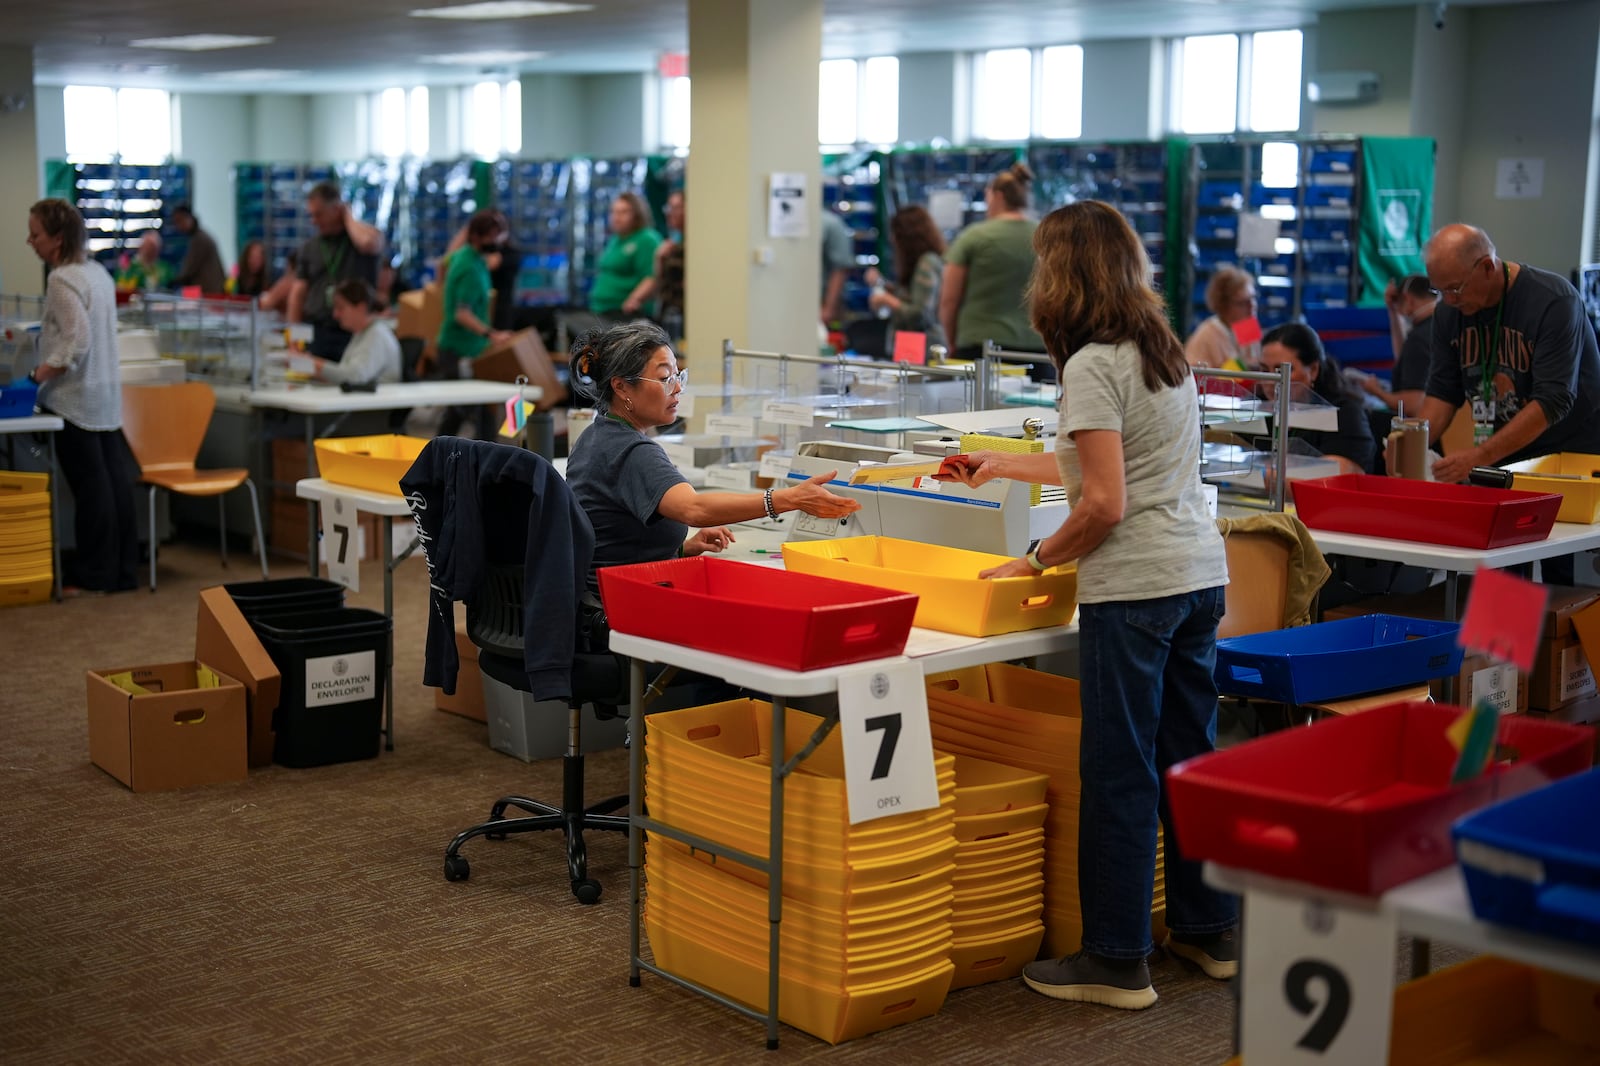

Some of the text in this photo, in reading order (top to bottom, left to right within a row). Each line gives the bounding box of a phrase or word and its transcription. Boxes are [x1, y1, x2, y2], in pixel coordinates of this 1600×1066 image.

[333, 524, 349, 564] 7
[311, 675, 371, 690] DECLARATION
[1565, 679, 1591, 693] ENVELOPES
[317, 686, 365, 699] ENVELOPES
[865, 712, 902, 781] 7
[877, 796, 901, 809] OPEX
[1284, 958, 1352, 1056] 9
